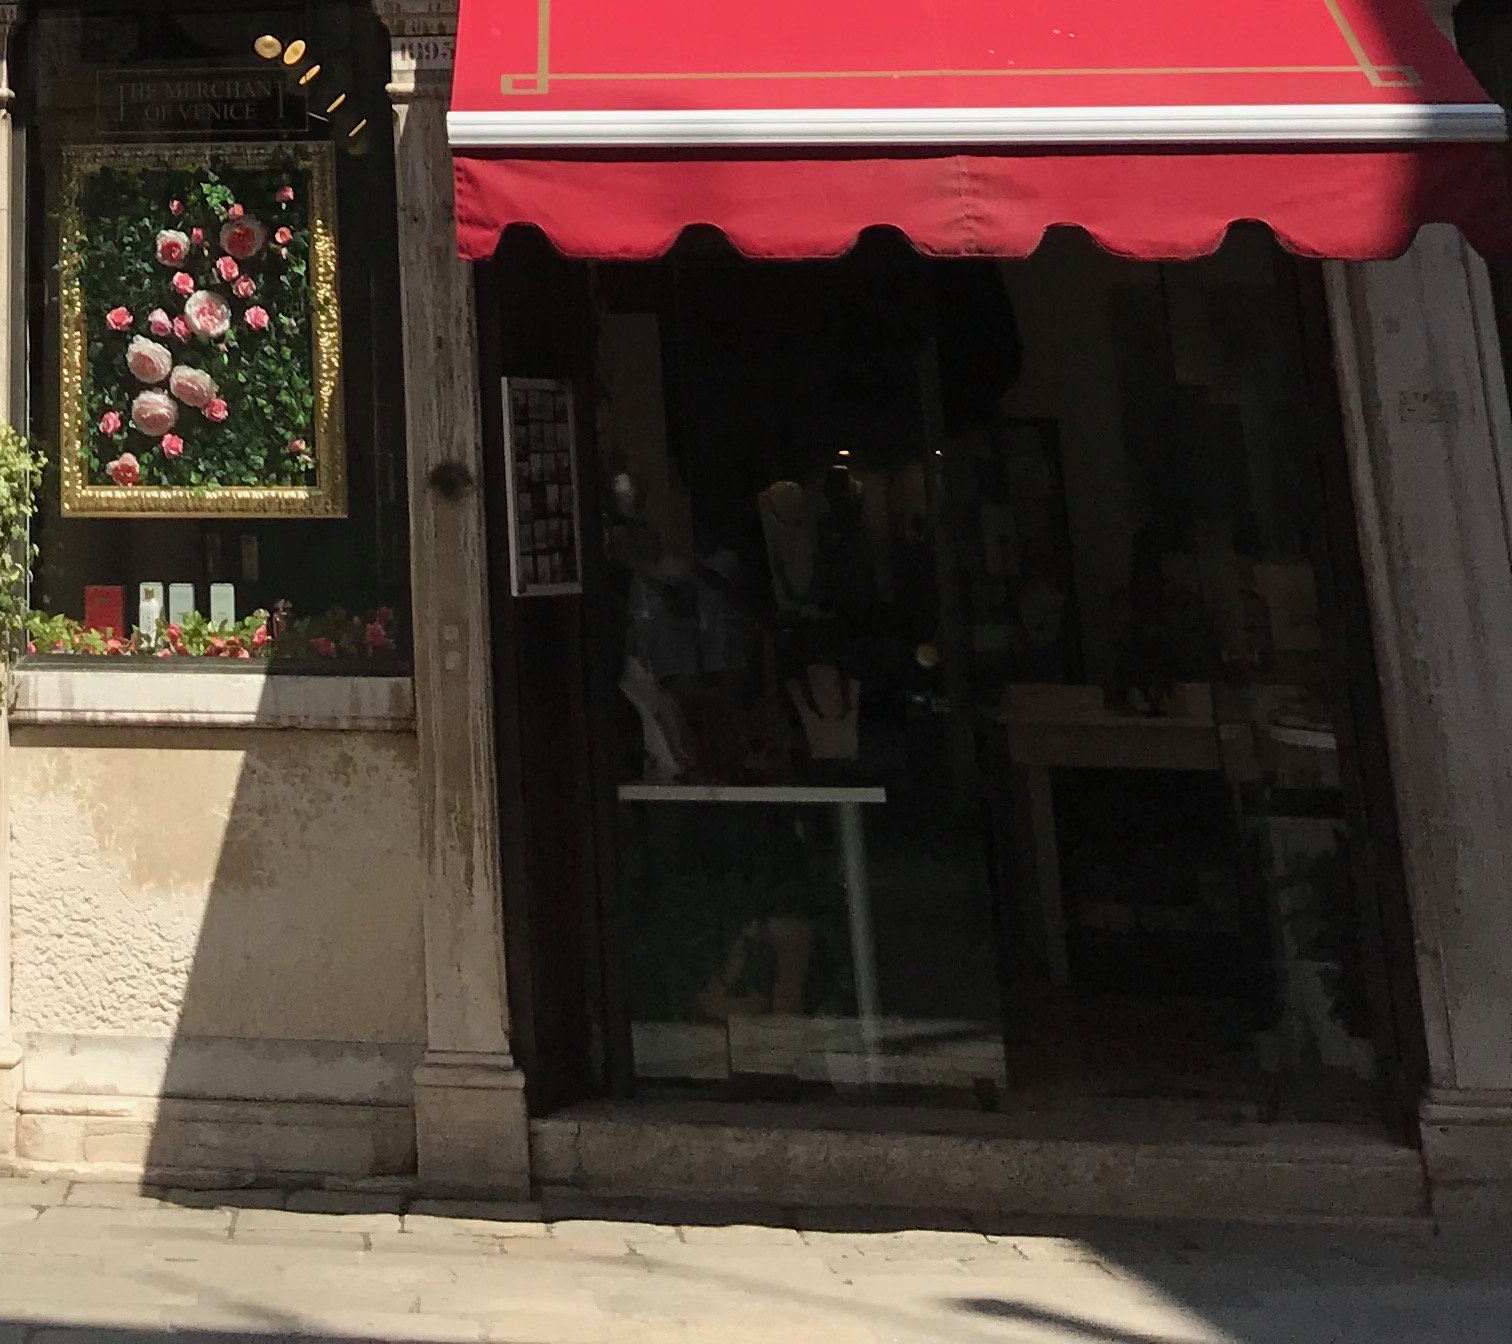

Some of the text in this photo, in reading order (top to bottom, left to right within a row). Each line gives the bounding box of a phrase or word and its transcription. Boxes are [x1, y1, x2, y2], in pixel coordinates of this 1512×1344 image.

[120, 80, 285, 121] THE MERCHANT
[144, 103, 257, 120] OF VENICE
